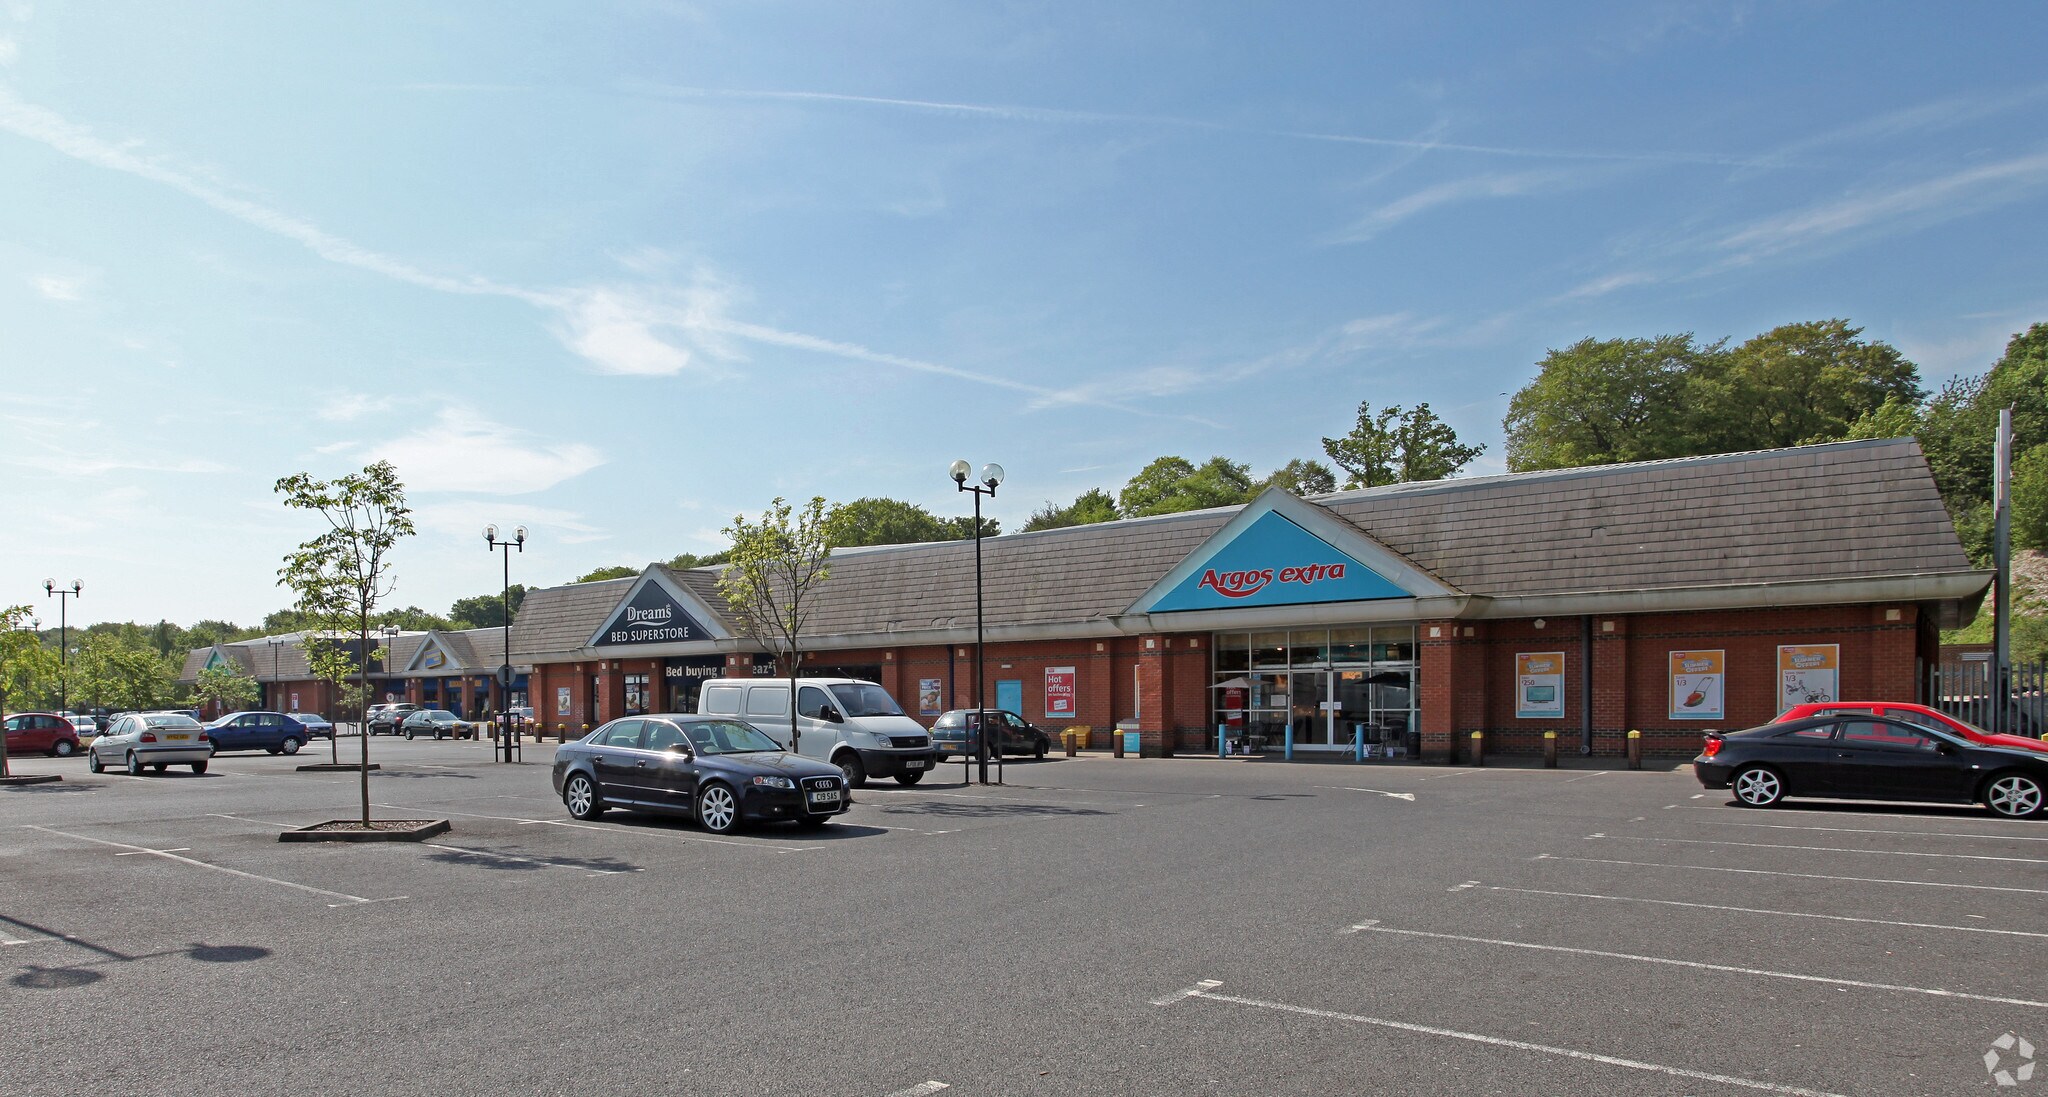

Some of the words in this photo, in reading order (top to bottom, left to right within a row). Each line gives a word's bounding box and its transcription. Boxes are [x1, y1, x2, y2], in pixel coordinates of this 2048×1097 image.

[1197, 568, 1275, 599] Argos
[1278, 562, 1347, 585] extra
[627, 603, 672, 622] Dreams
[611, 631, 628, 642] BED
[631, 626, 689, 641] SUPERSTORE
[665, 666, 683, 677] Bed
[685, 665, 718, 679] buying
[1048, 675, 1063, 683] Hot
[1047, 684, 1071, 692] offers
[826, 791, 838, 800] SAS
